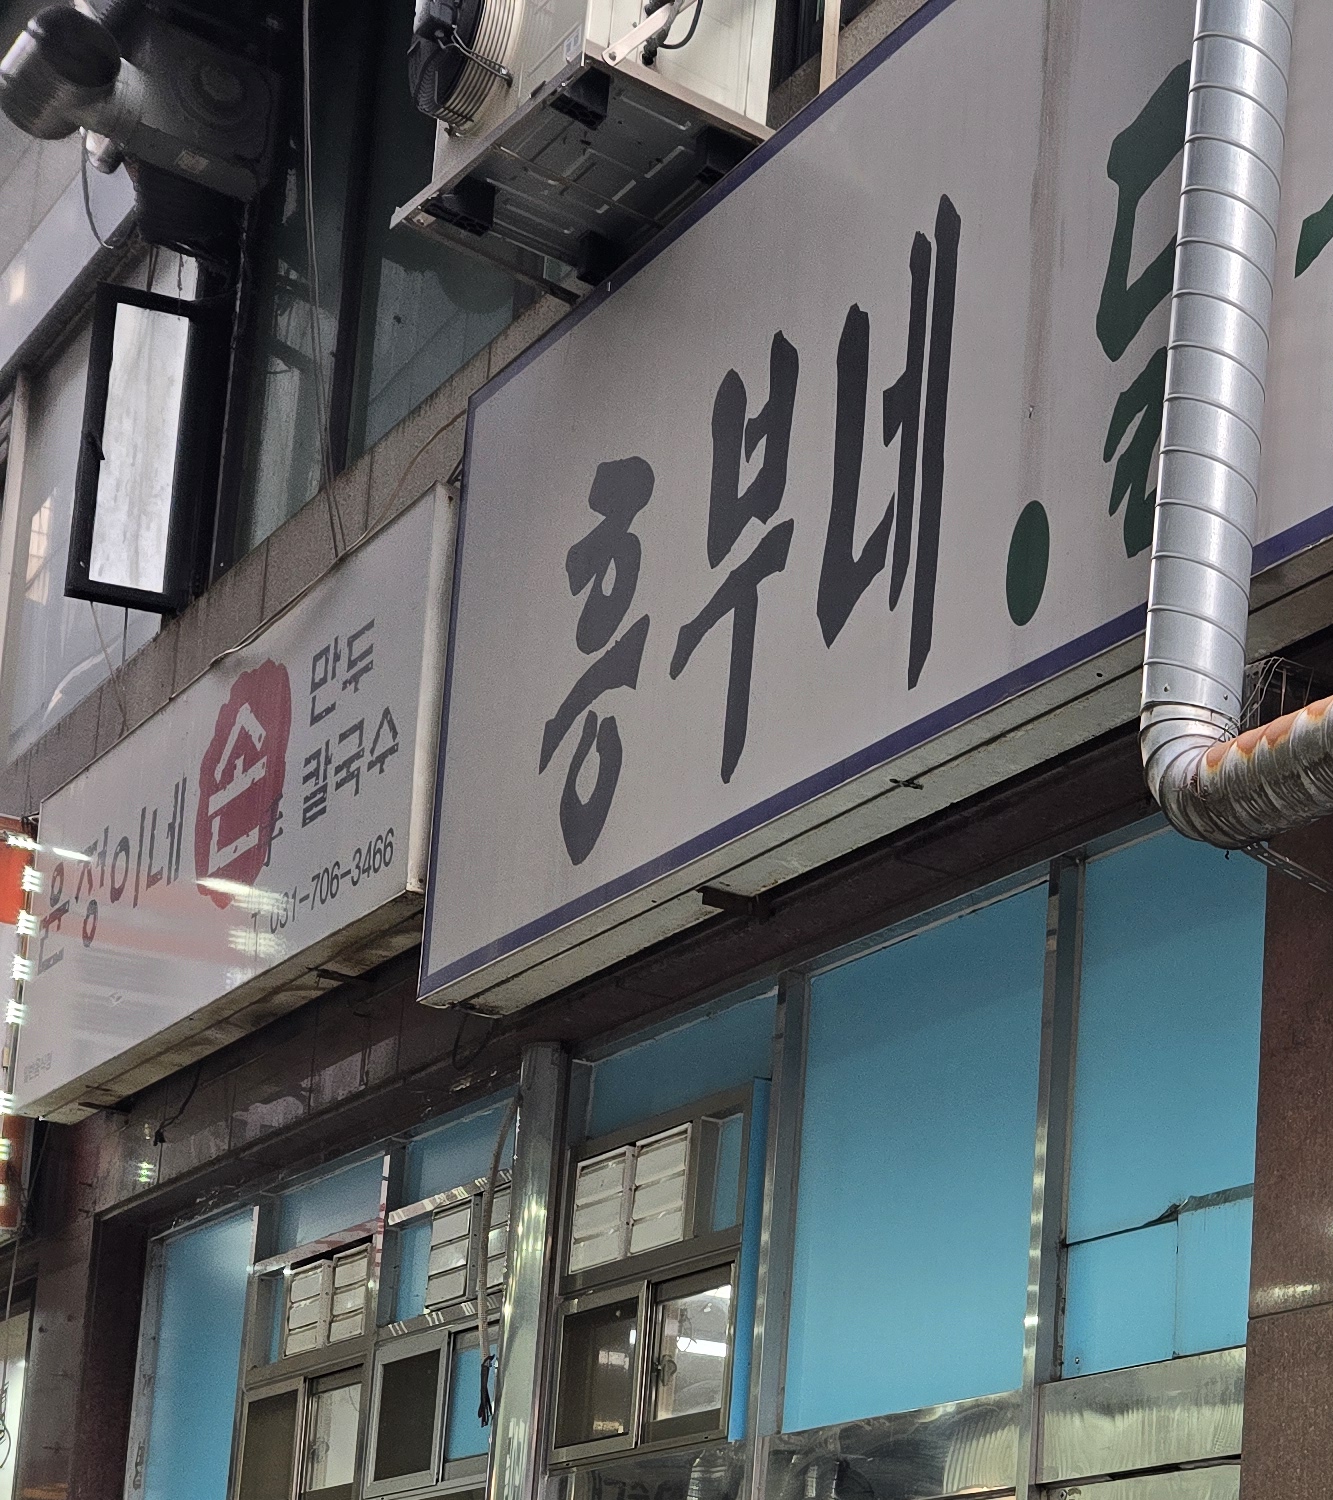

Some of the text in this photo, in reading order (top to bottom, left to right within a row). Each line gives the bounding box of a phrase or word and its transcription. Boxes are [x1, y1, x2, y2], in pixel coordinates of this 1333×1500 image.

[538, 194, 960, 865] 흥부네
[309, 618, 374, 727] 만두
[208, 702, 267, 877] 손
[302, 706, 399, 828] 칼국수
